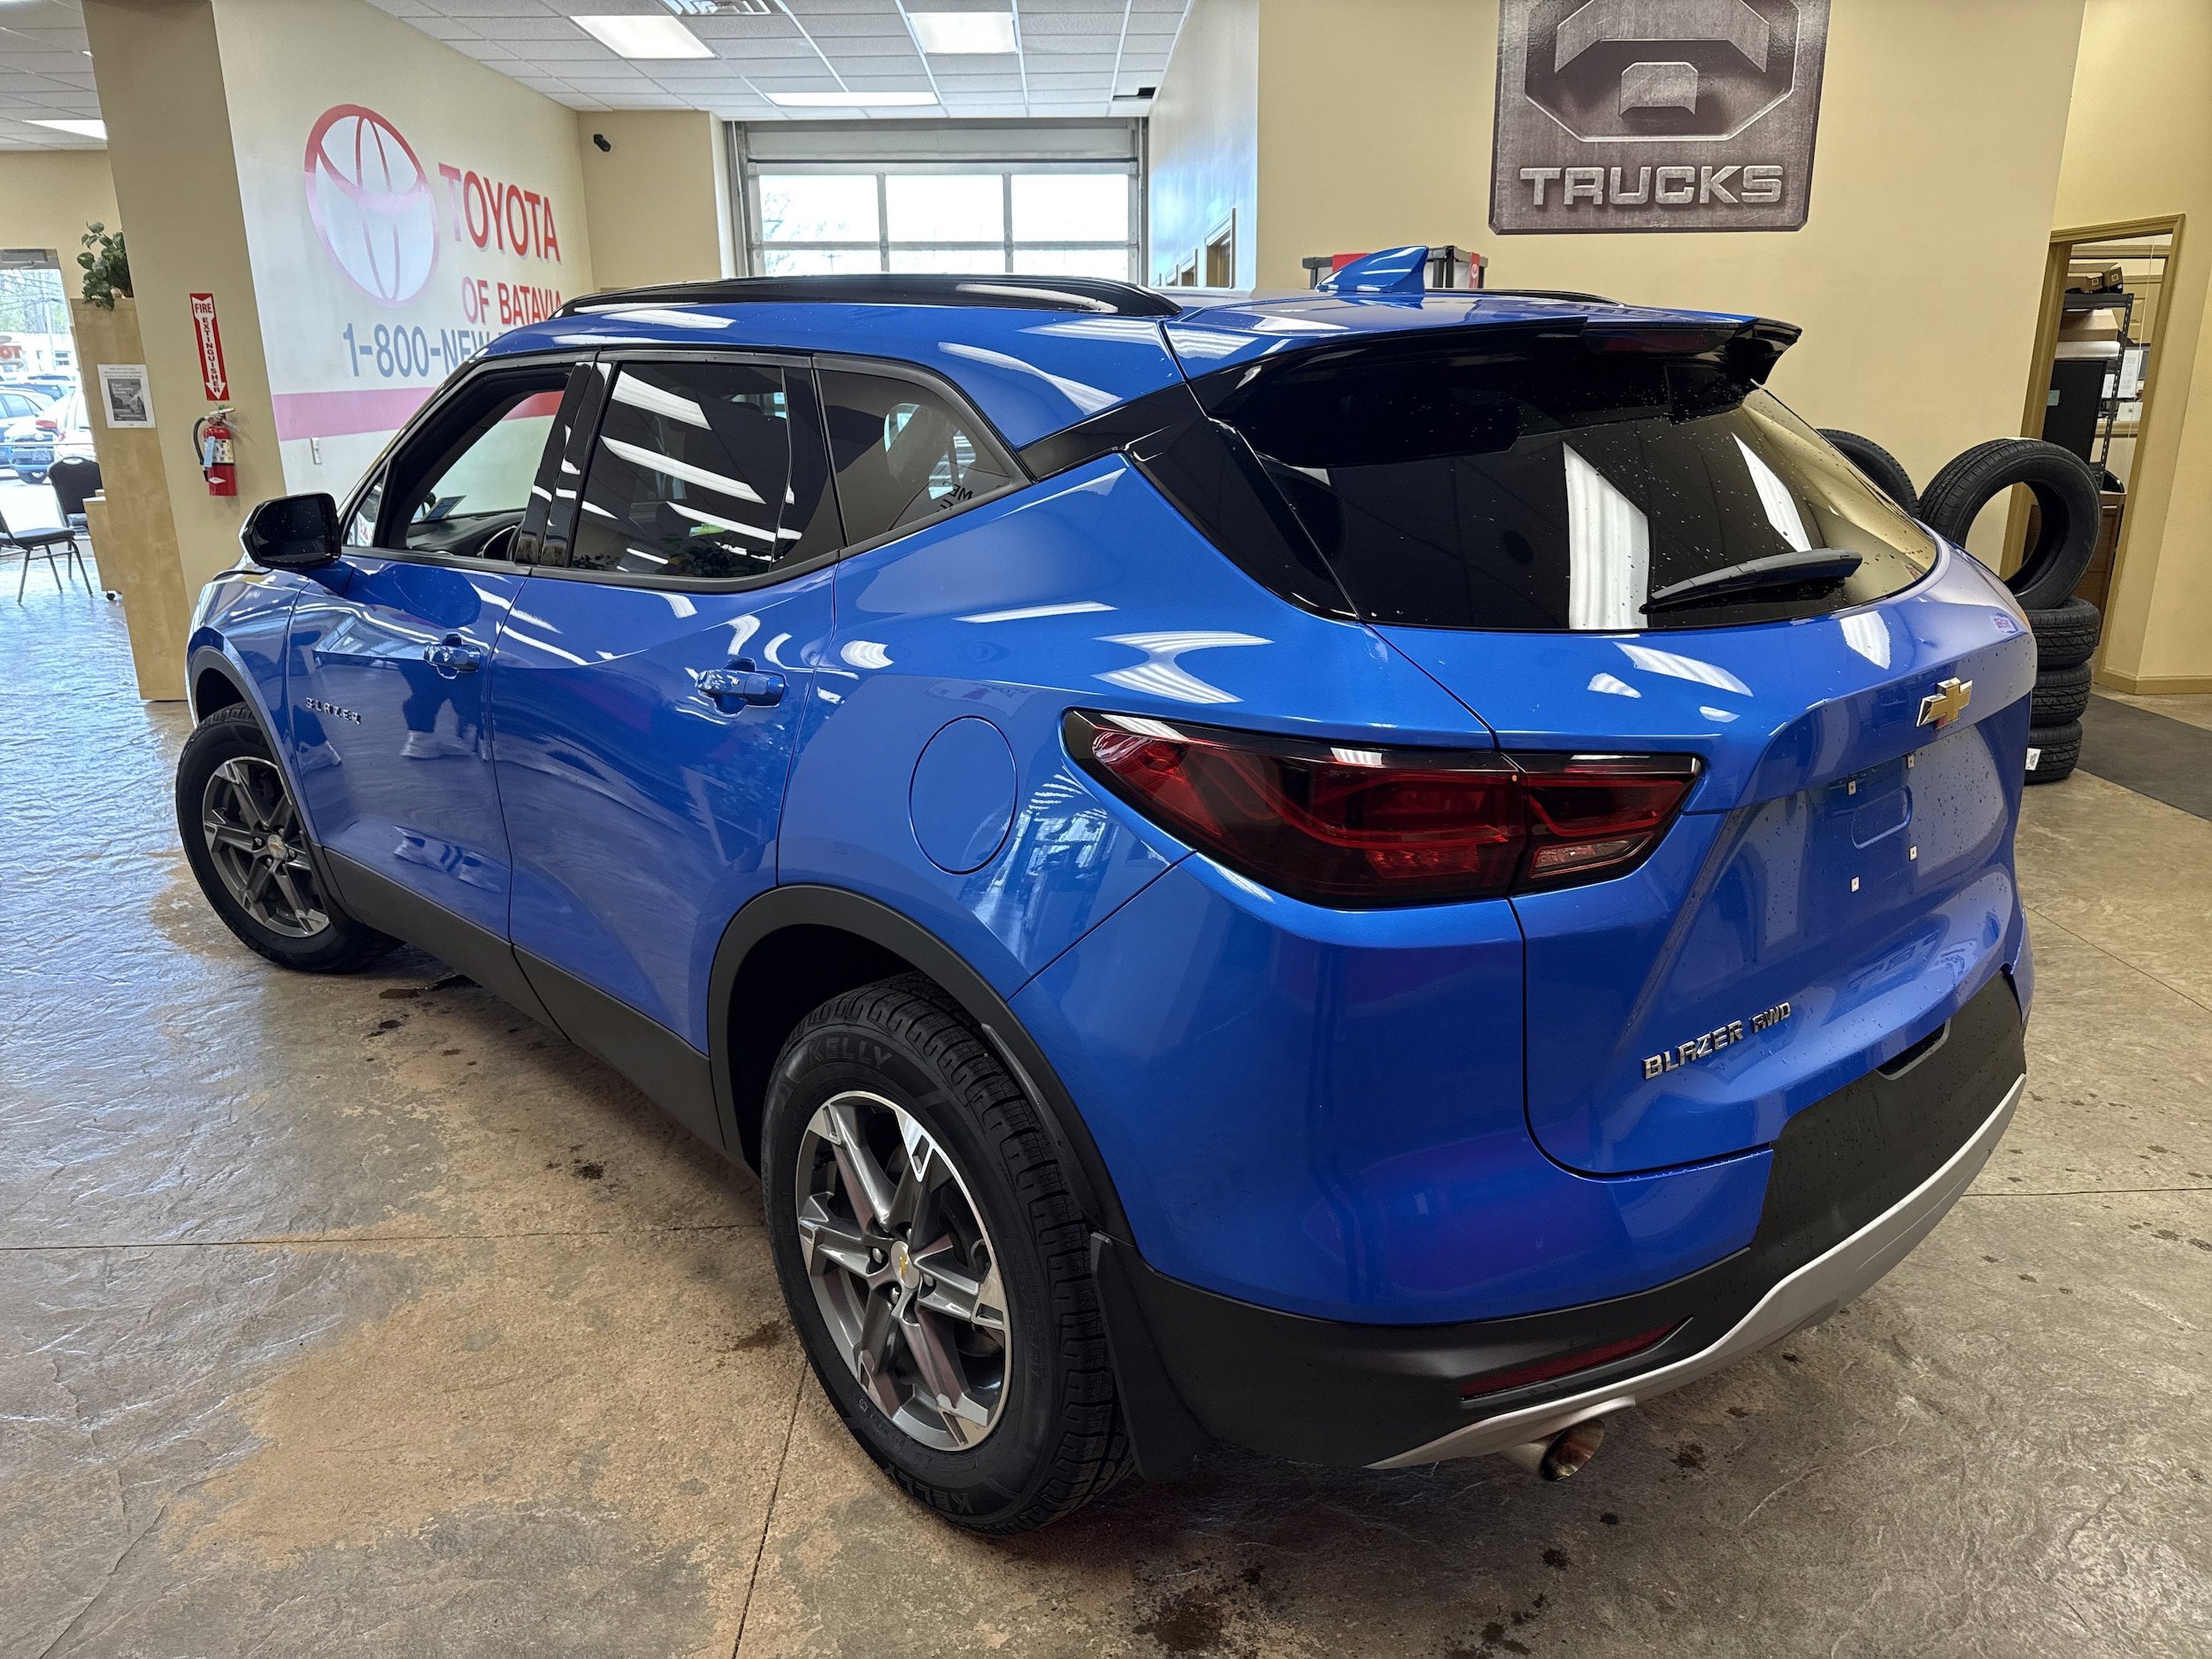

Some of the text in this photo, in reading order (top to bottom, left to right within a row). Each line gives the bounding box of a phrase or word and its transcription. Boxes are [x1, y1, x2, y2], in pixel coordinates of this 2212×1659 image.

[1519, 165, 1784, 205] TRUCKS
[439, 163, 562, 263] TOYOTA
[194, 303, 212, 314] FIRE
[461, 276, 489, 324] OF
[202, 317, 220, 393] EXTINGUISHER
[305, 696, 362, 726] BLAZER
[807, 1037, 893, 1071] KELLY
[1643, 1001, 1792, 1080] BLAZER AWD
